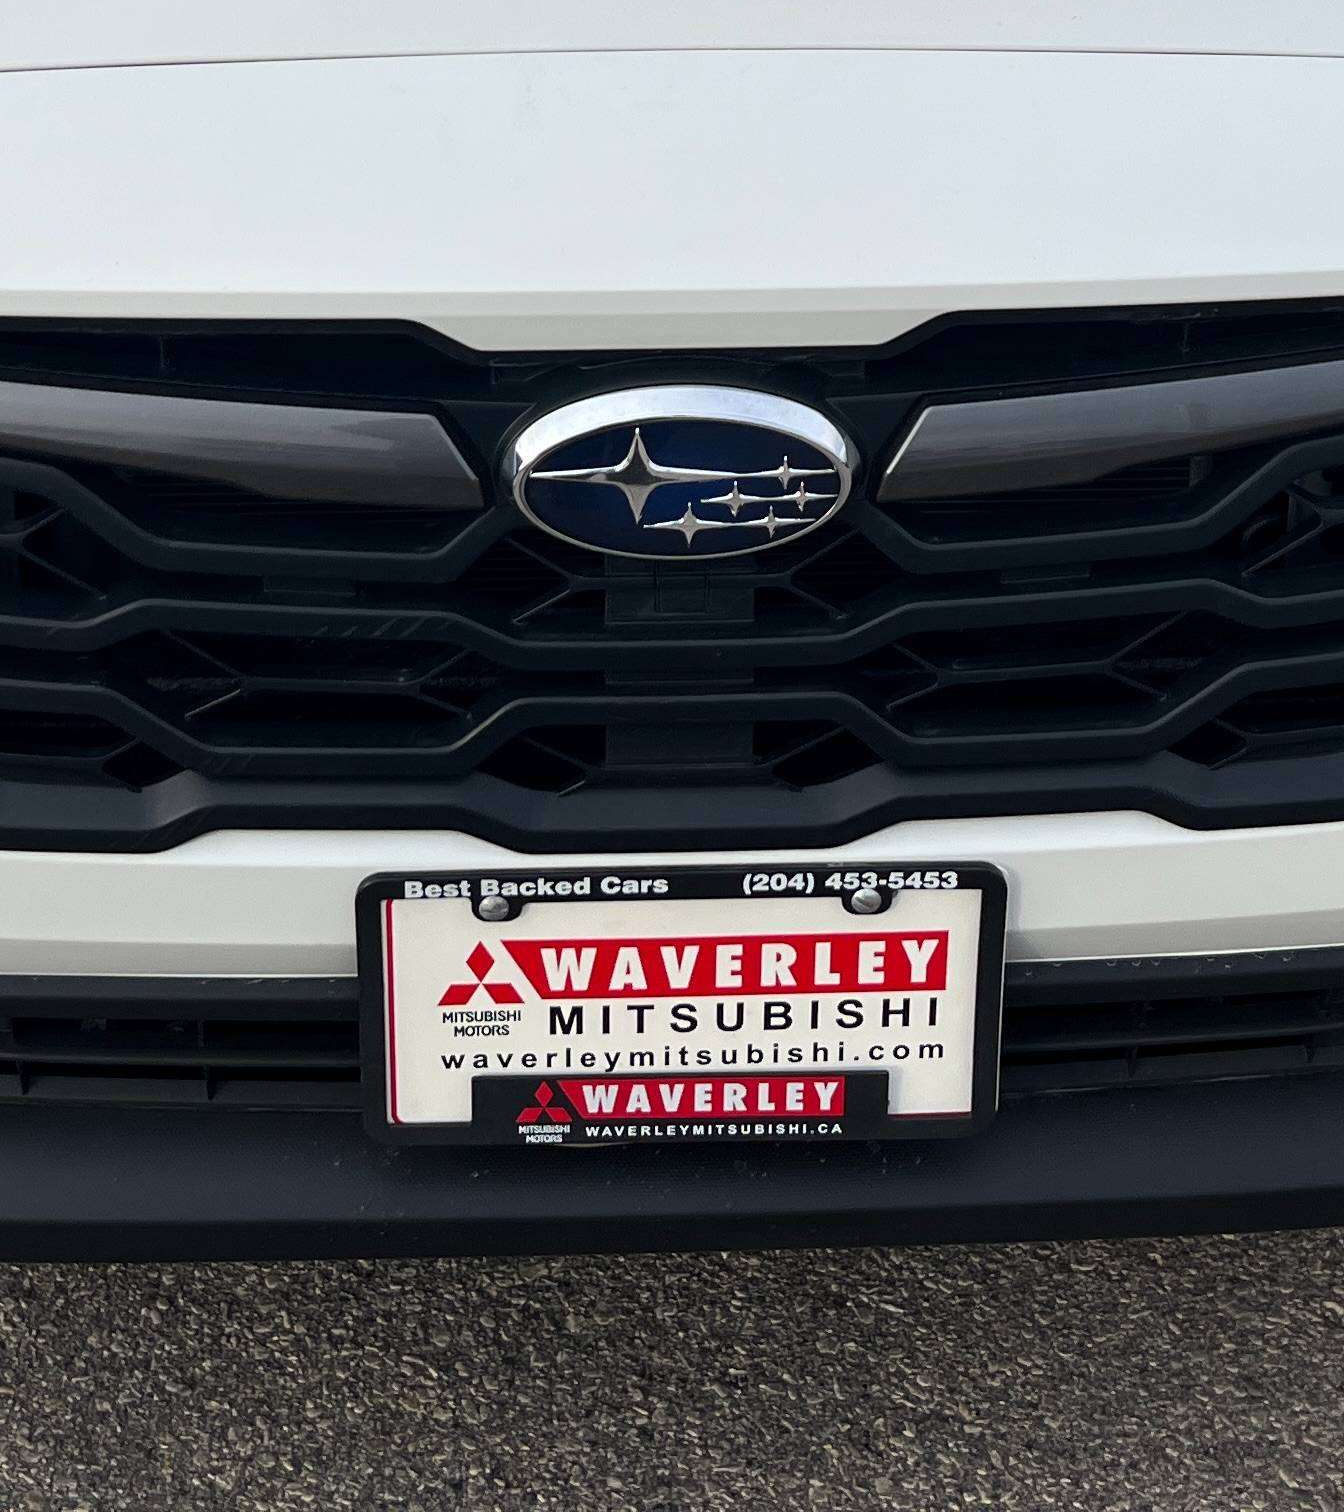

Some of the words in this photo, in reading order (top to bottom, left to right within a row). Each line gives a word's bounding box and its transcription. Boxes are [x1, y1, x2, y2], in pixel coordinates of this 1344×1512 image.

[404, 880, 471, 898] Best
[480, 877, 591, 896] Backed
[600, 876, 669, 894] Cars
[743, 872, 814, 895] (204)
[824, 871, 958, 890] 453-5453
[540, 939, 939, 991] WAVERLEY
[442, 1009, 521, 1023] MITSUBISHI
[549, 997, 938, 1035] MITSUBISHI
[453, 1024, 510, 1037] MOTORS
[441, 1041, 944, 1073] waverleymitsubishi.com
[582, 1082, 839, 1113] WAVERLEY
[518, 1124, 570, 1134] MITSUBISHI
[525, 1134, 563, 1144] MOTORS
[585, 1123, 843, 1137] WAVERLEYMITSUBISHI.CA
